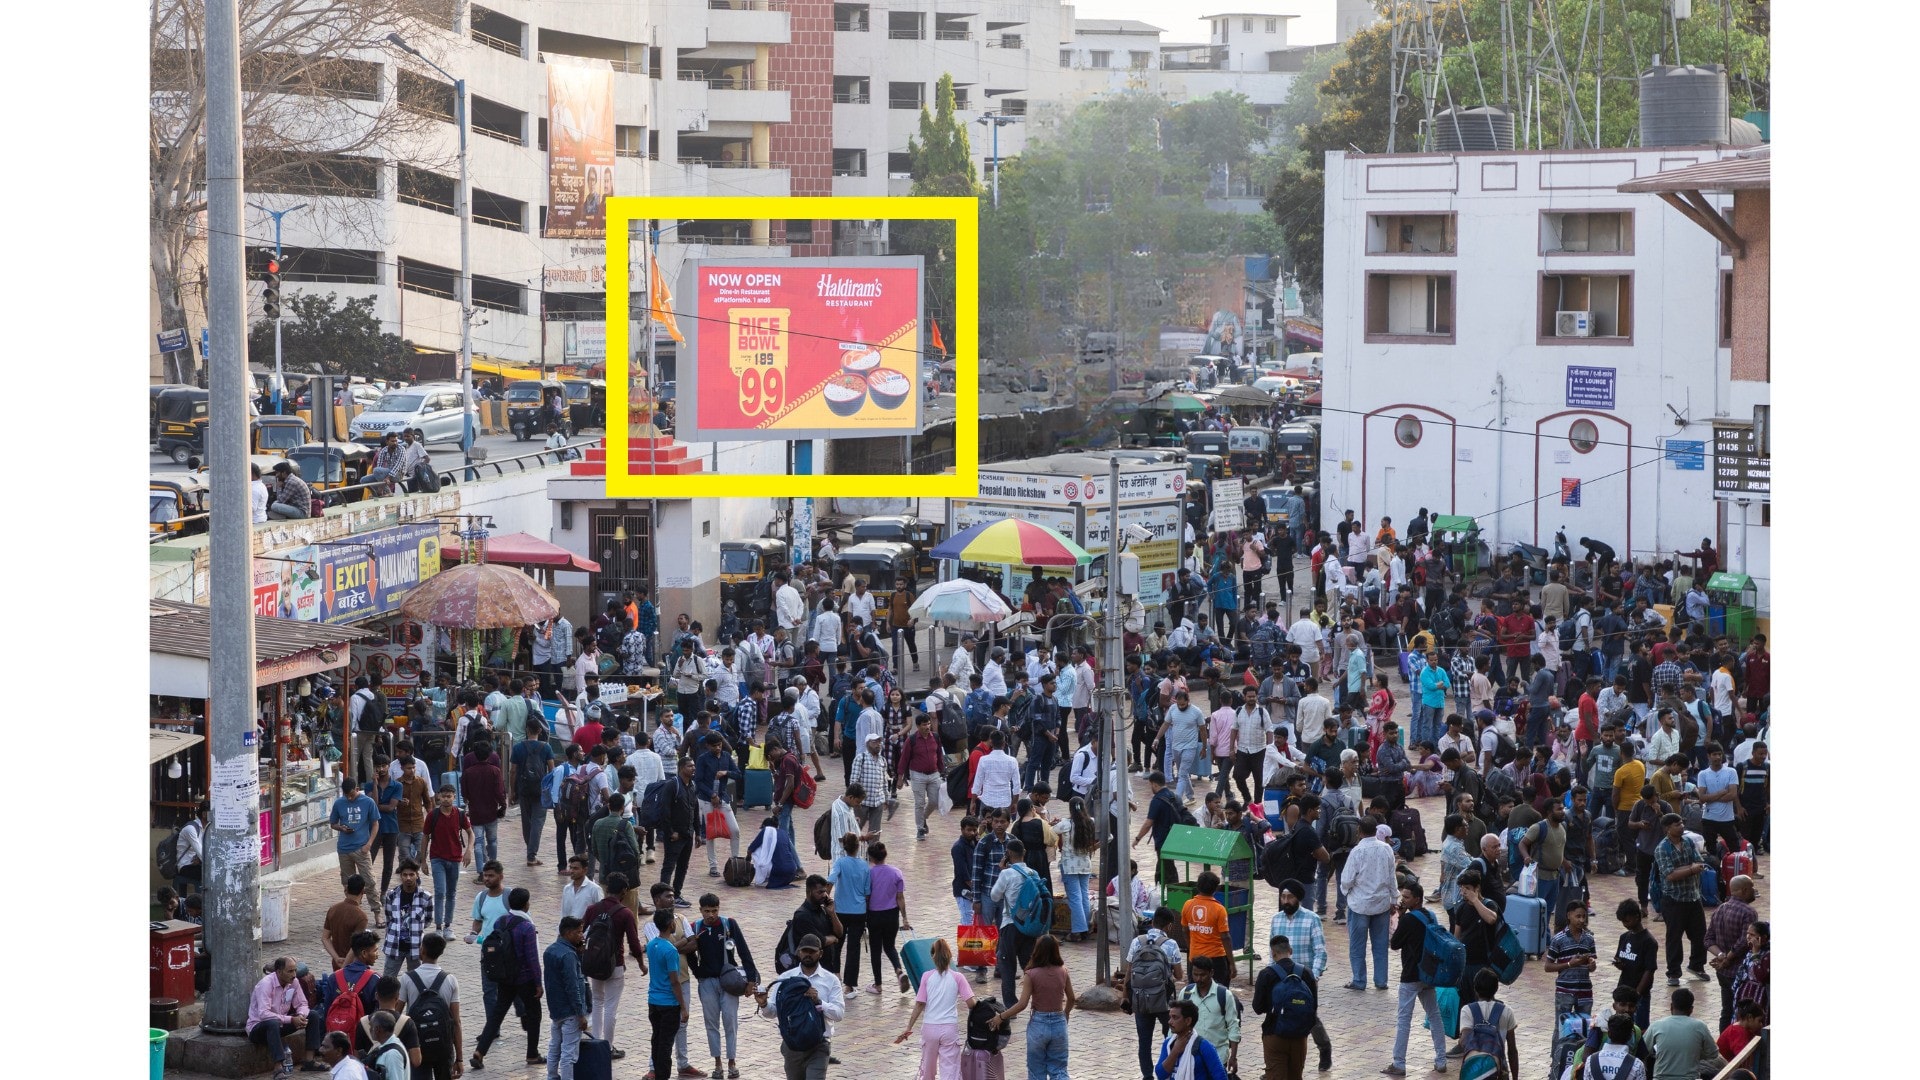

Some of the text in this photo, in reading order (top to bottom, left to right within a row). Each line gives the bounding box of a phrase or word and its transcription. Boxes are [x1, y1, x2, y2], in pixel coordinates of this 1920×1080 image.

[708, 273, 781, 287] NOW OPEN
[816, 273, 883, 298] Haldiram's
[738, 317, 780, 335] RICE
[738, 336, 781, 350] BOWL
[741, 367, 784, 414] 99
[979, 484, 1047, 499] Prepaid Auto Rickshaw
[1718, 480, 1770, 490] 11077 JHELUM
[335, 561, 368, 592] EXIT
[337, 589, 366, 609] बाहेर
